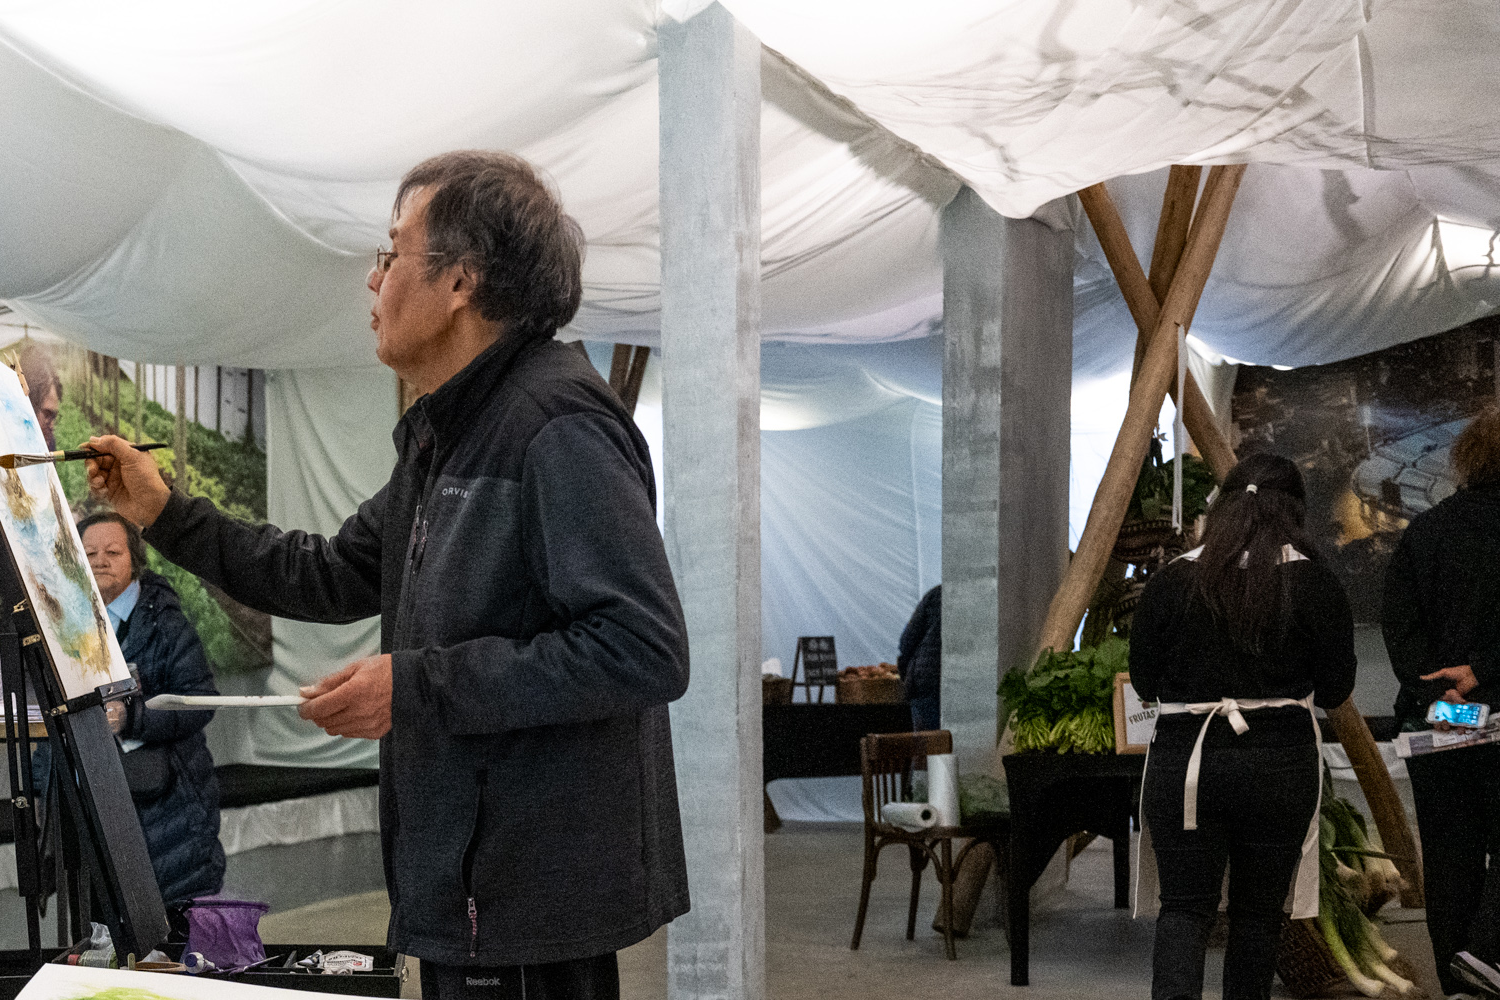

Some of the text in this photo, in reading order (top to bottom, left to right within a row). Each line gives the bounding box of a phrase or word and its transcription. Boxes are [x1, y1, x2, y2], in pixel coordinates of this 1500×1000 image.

[442, 487, 469, 498] ORVIS
[1129, 711, 1156, 724] FRUTAS
[466, 978, 501, 986] Reebok
